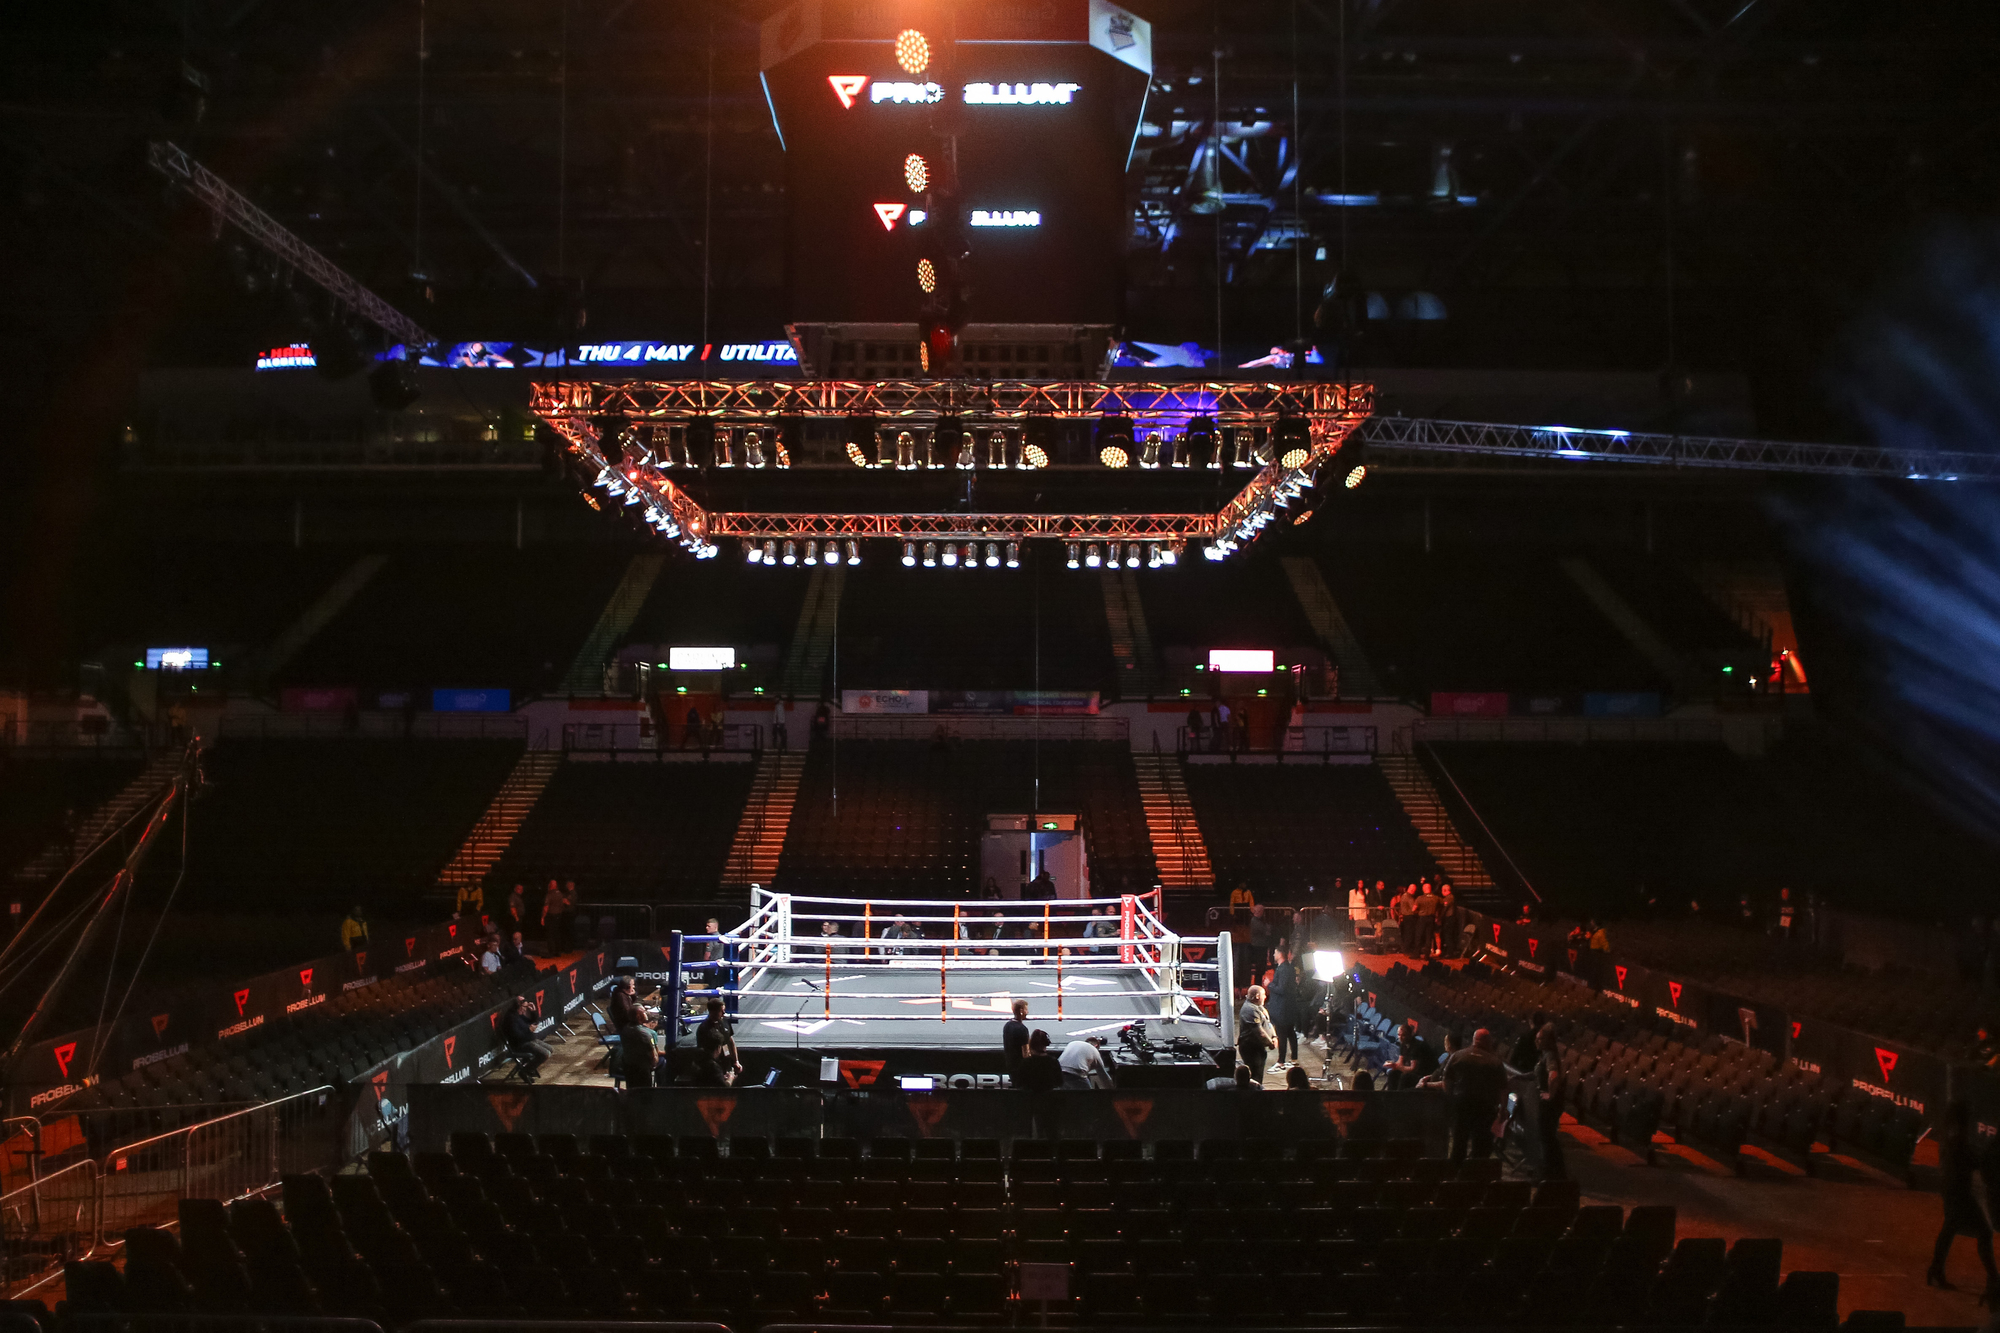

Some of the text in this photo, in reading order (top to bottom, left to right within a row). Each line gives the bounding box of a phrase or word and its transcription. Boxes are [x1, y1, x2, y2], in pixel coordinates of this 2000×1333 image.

[579, 345, 621, 361] THU
[623, 345, 640, 361] 4
[644, 345, 694, 361] MAY
